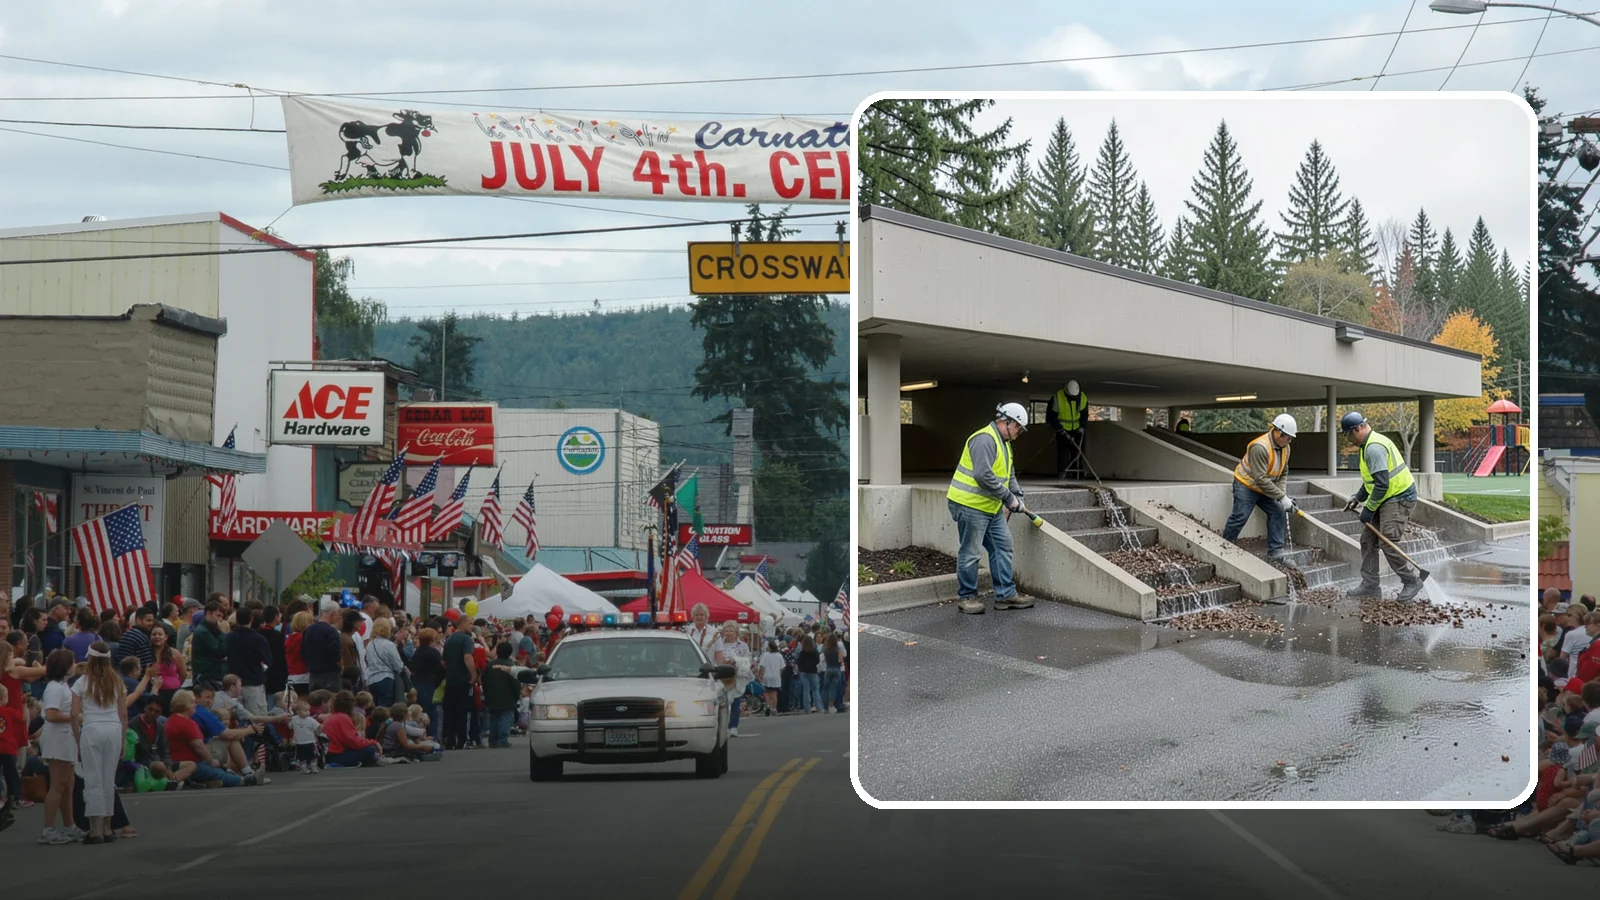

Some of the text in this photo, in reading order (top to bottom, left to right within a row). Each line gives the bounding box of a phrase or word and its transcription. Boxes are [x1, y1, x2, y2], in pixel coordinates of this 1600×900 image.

[481, 141, 605, 192] JULY
[632, 150, 746, 198] 4th.
[697, 254, 850, 280] CROSSWA
[282, 380, 373, 420] ACE
[406, 409, 486, 422] CEDAR LOG
[283, 421, 371, 437] Hardware
[416, 428, 476, 447] Coca-Cola
[353, 467, 385, 480] Simpl
[83, 485, 155, 495] St. Vincent de Paul
[212, 516, 332, 536] HARDARE
[688, 526, 742, 535] CRNATION
[699, 535, 730, 543] GLASS
